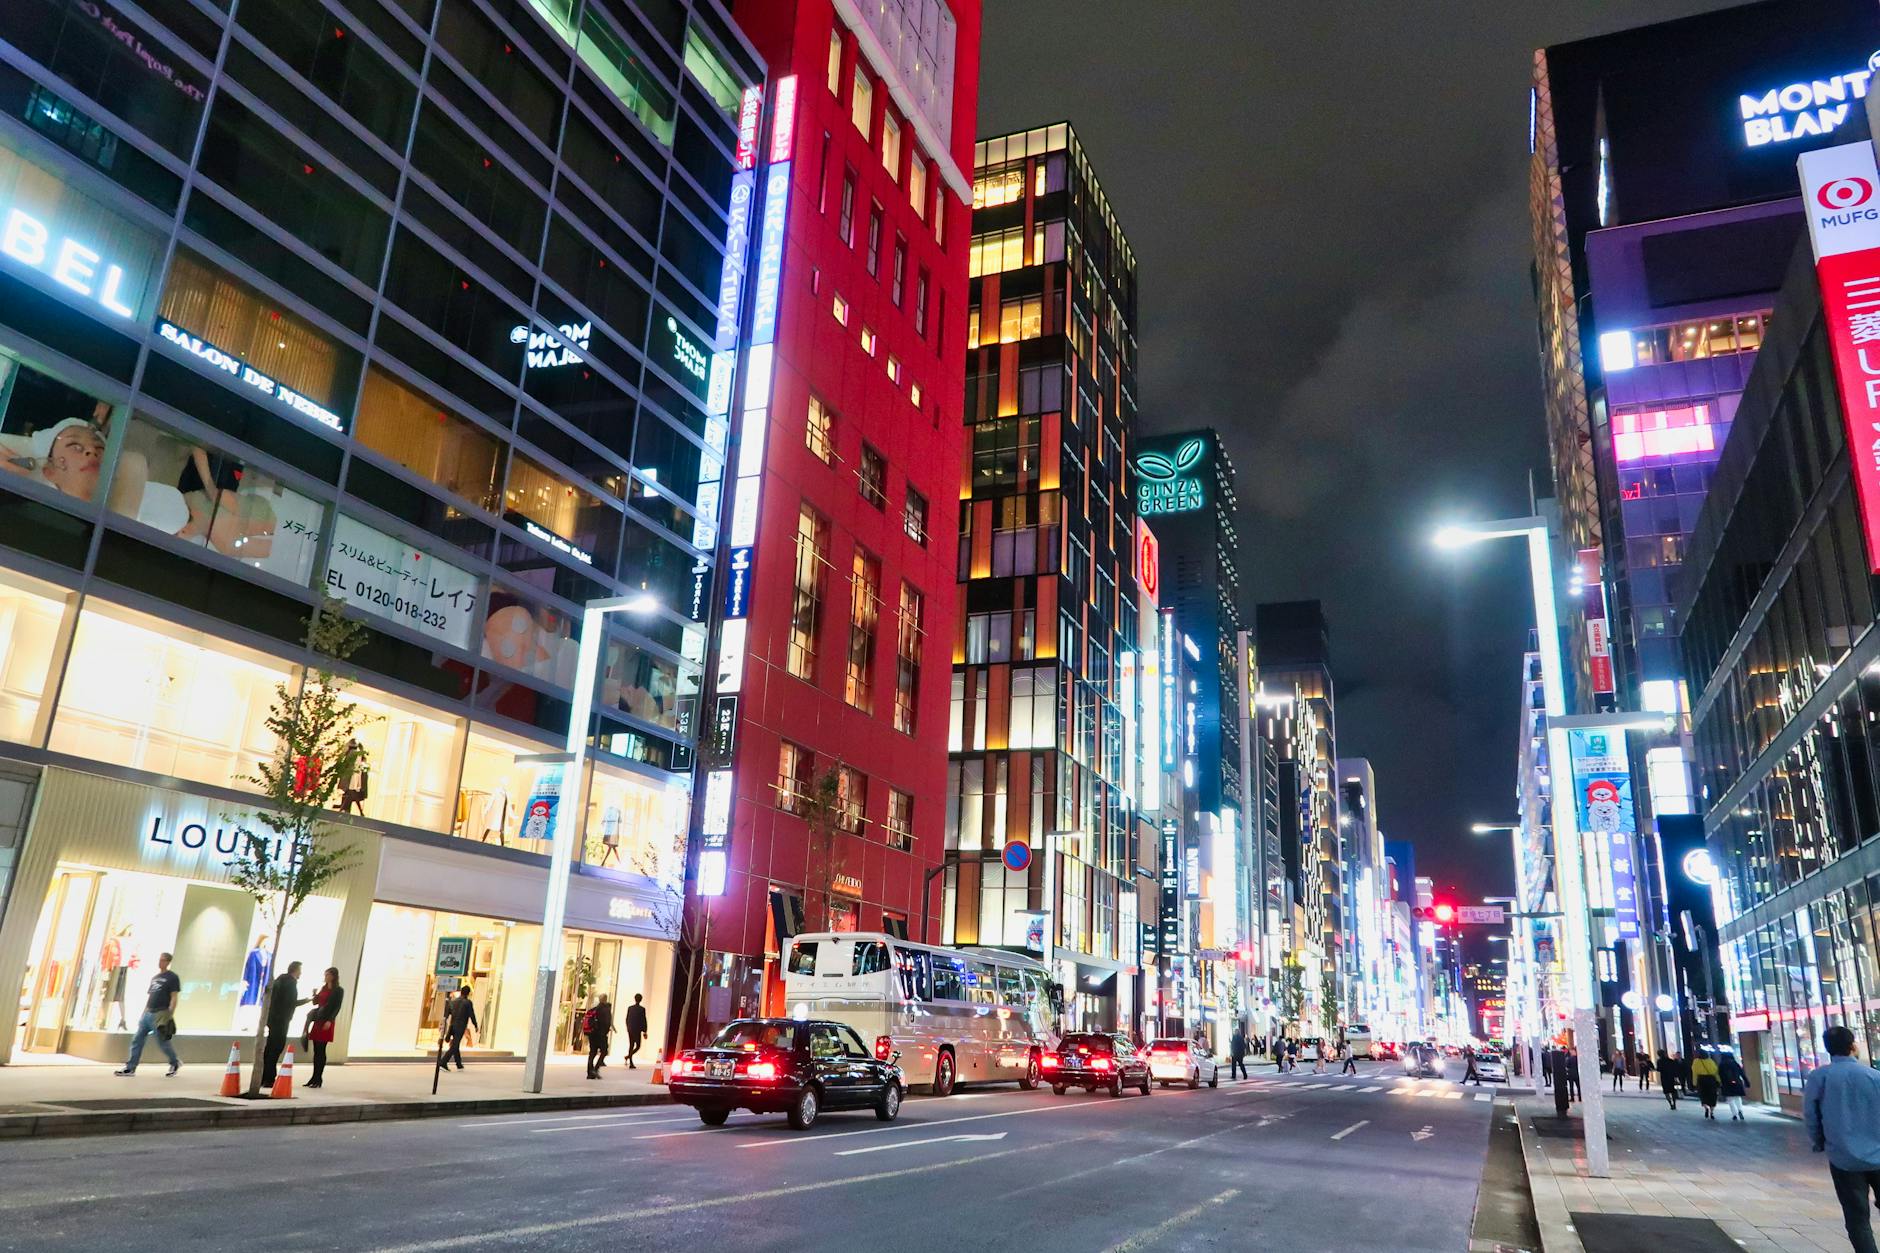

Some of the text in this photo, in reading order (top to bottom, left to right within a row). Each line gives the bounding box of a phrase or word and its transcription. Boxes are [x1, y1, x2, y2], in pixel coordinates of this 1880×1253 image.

[1740, 69, 1871, 119] MONT
[1821, 208, 1879, 229] MUFG
[2, 207, 133, 318] BEL
[160, 323, 240, 375] SALON
[243, 367, 275, 395] DE
[1139, 478, 1200, 498] GINZA
[1139, 494, 1201, 514] GREEN
[355, 581, 447, 630] 0120-018-232
[834, 872, 862, 889] SHISEIDO
